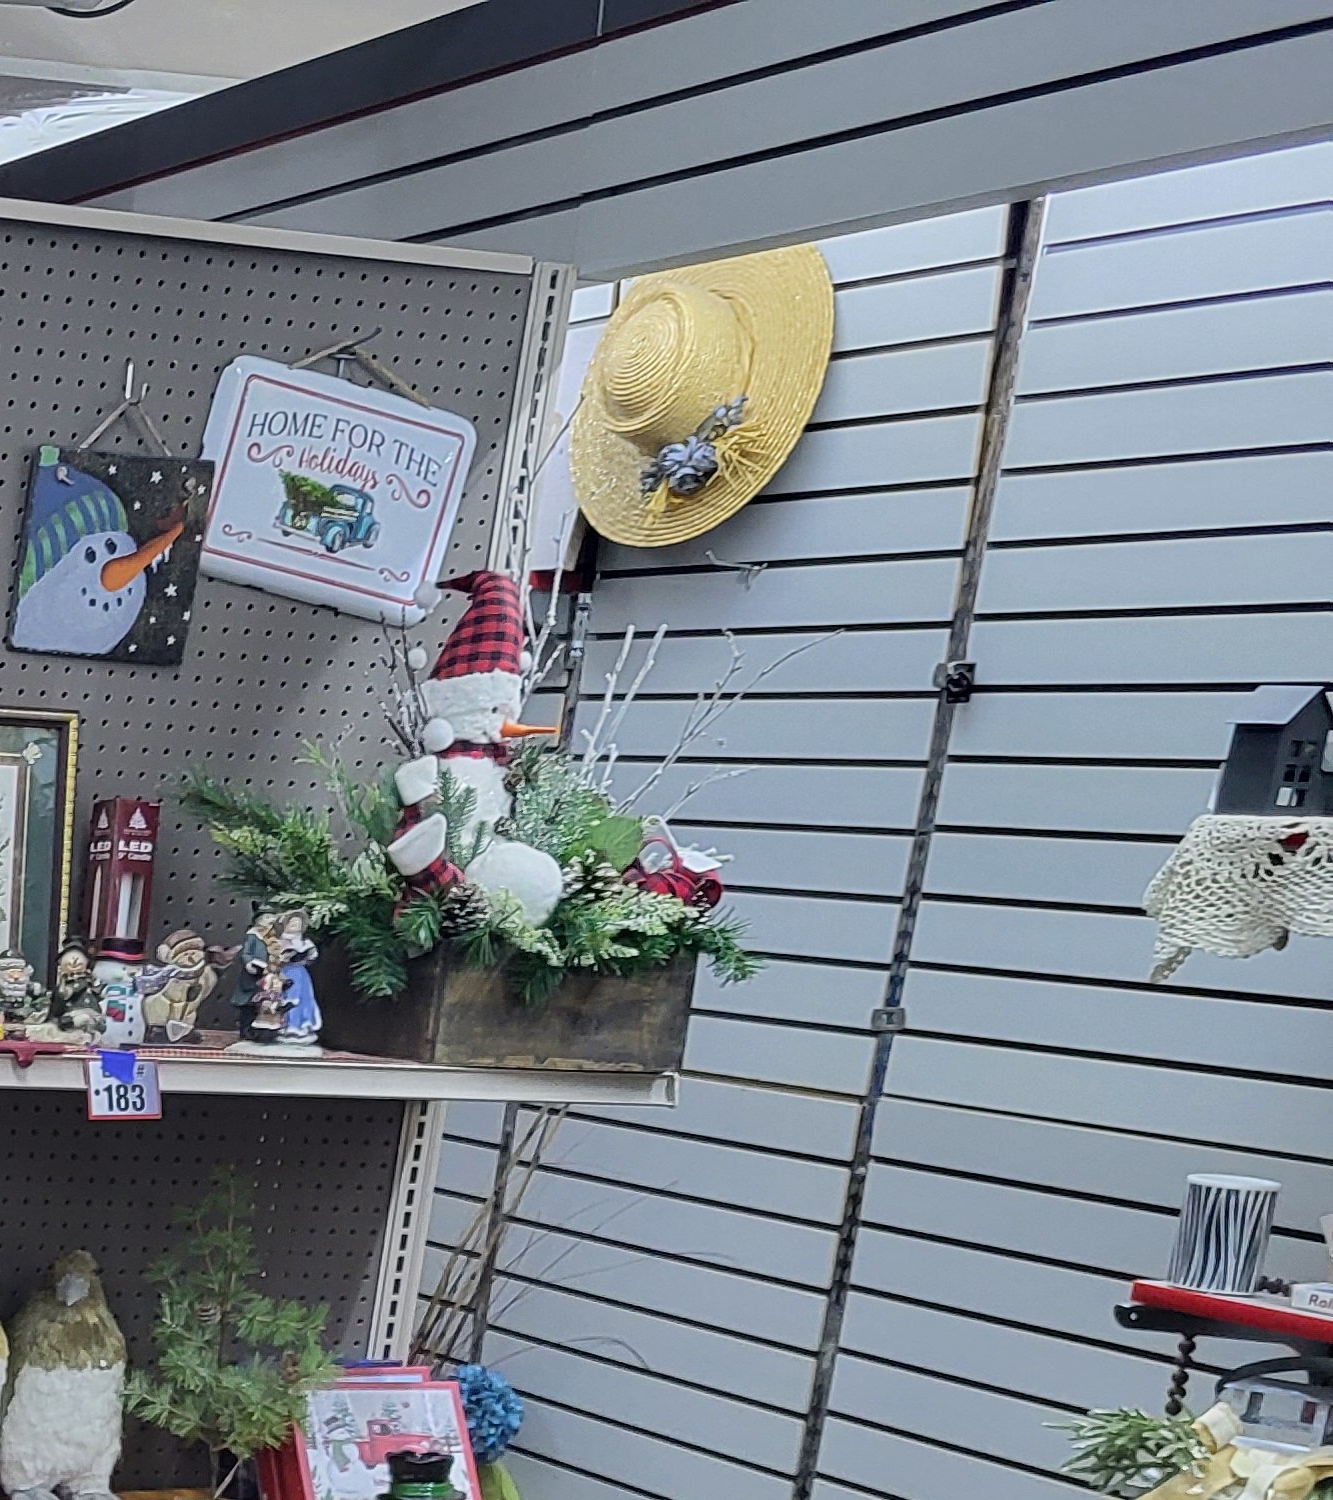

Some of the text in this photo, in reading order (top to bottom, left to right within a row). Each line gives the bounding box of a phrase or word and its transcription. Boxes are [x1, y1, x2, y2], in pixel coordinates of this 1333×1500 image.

[247, 411, 443, 487] HOME FOR THE
[298, 445, 380, 492] Holidays
[89, 841, 112, 853] LED
[118, 839, 153, 853] LED
[102, 1084, 146, 1112] 183
